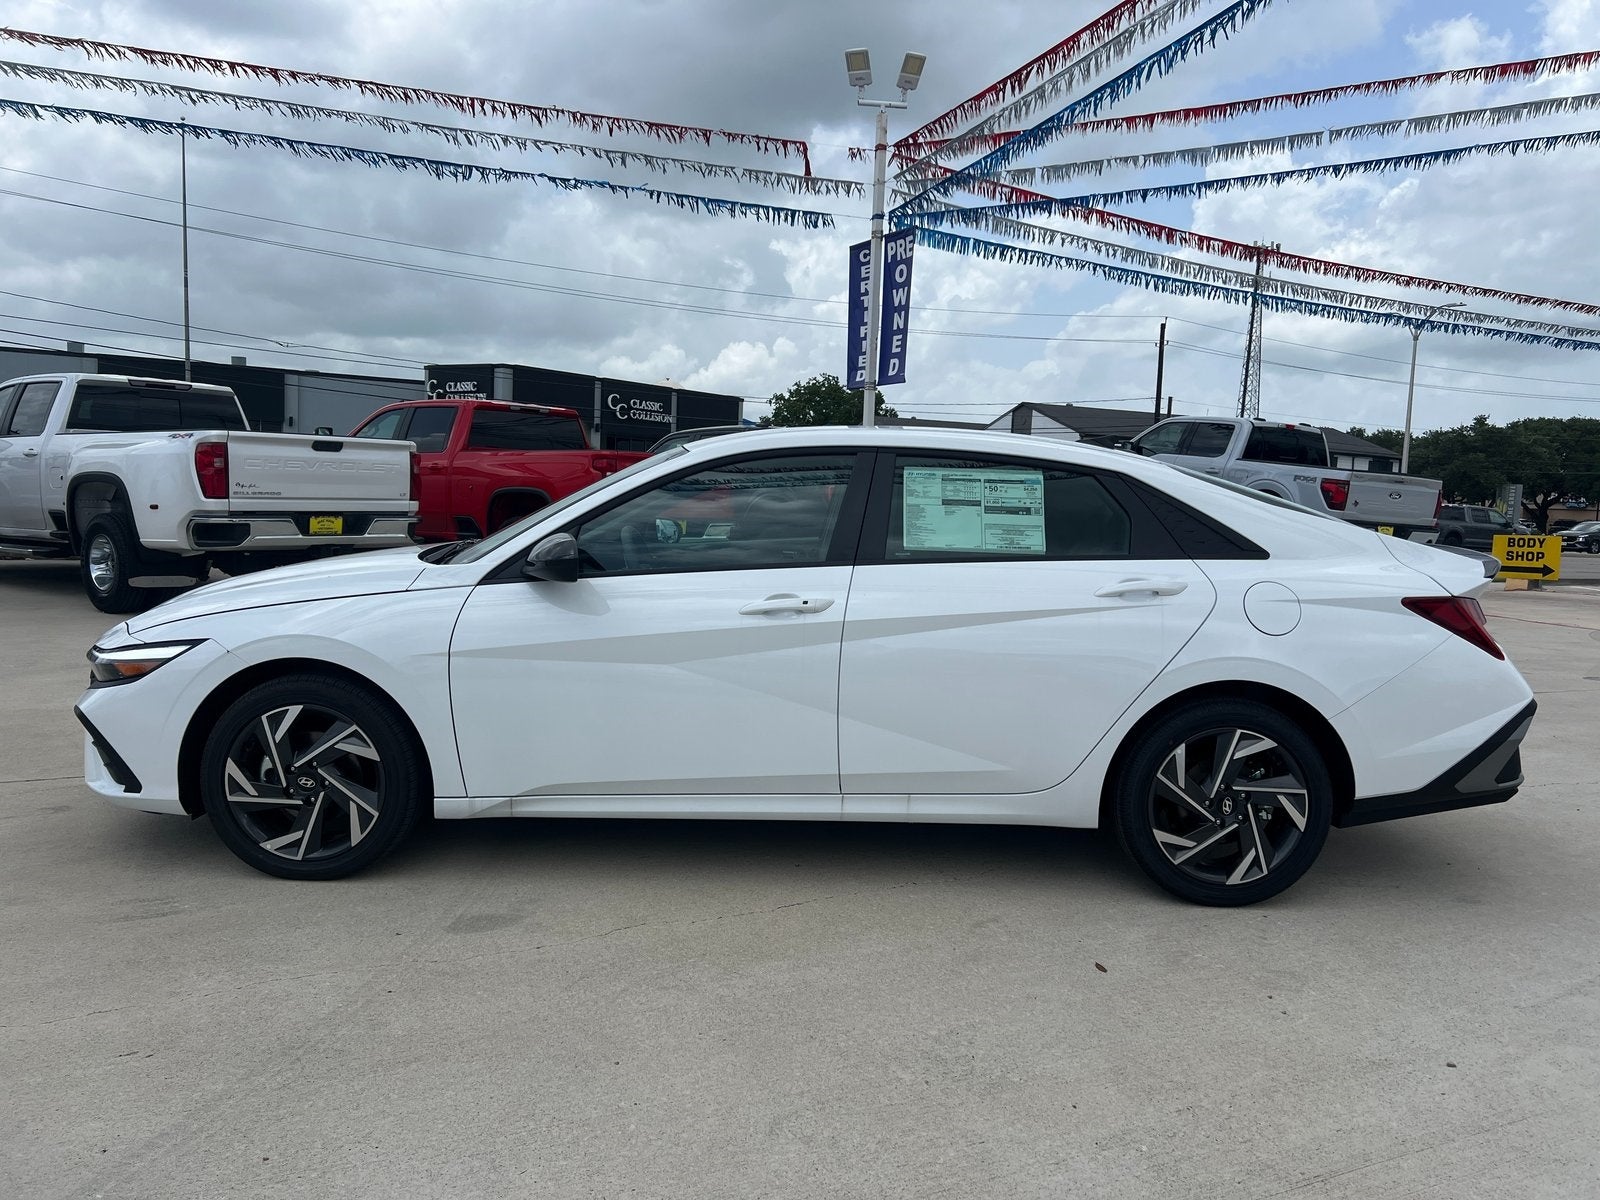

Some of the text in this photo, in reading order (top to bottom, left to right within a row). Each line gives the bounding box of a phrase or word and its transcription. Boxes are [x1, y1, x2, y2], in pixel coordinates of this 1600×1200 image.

[887, 235, 914, 263] PRE
[888, 264, 908, 377] OWNED
[446, 381, 477, 392] CLASSIC
[630, 399, 663, 412] CLASSIC
[630, 410, 673, 423] COLLISION
[242, 458, 400, 474] CHEVROLET
[1294, 475, 1317, 483] FX4
[988, 485, 999, 493] 50
[1507, 537, 1546, 549] BODY
[1505, 551, 1545, 562] SHOP
